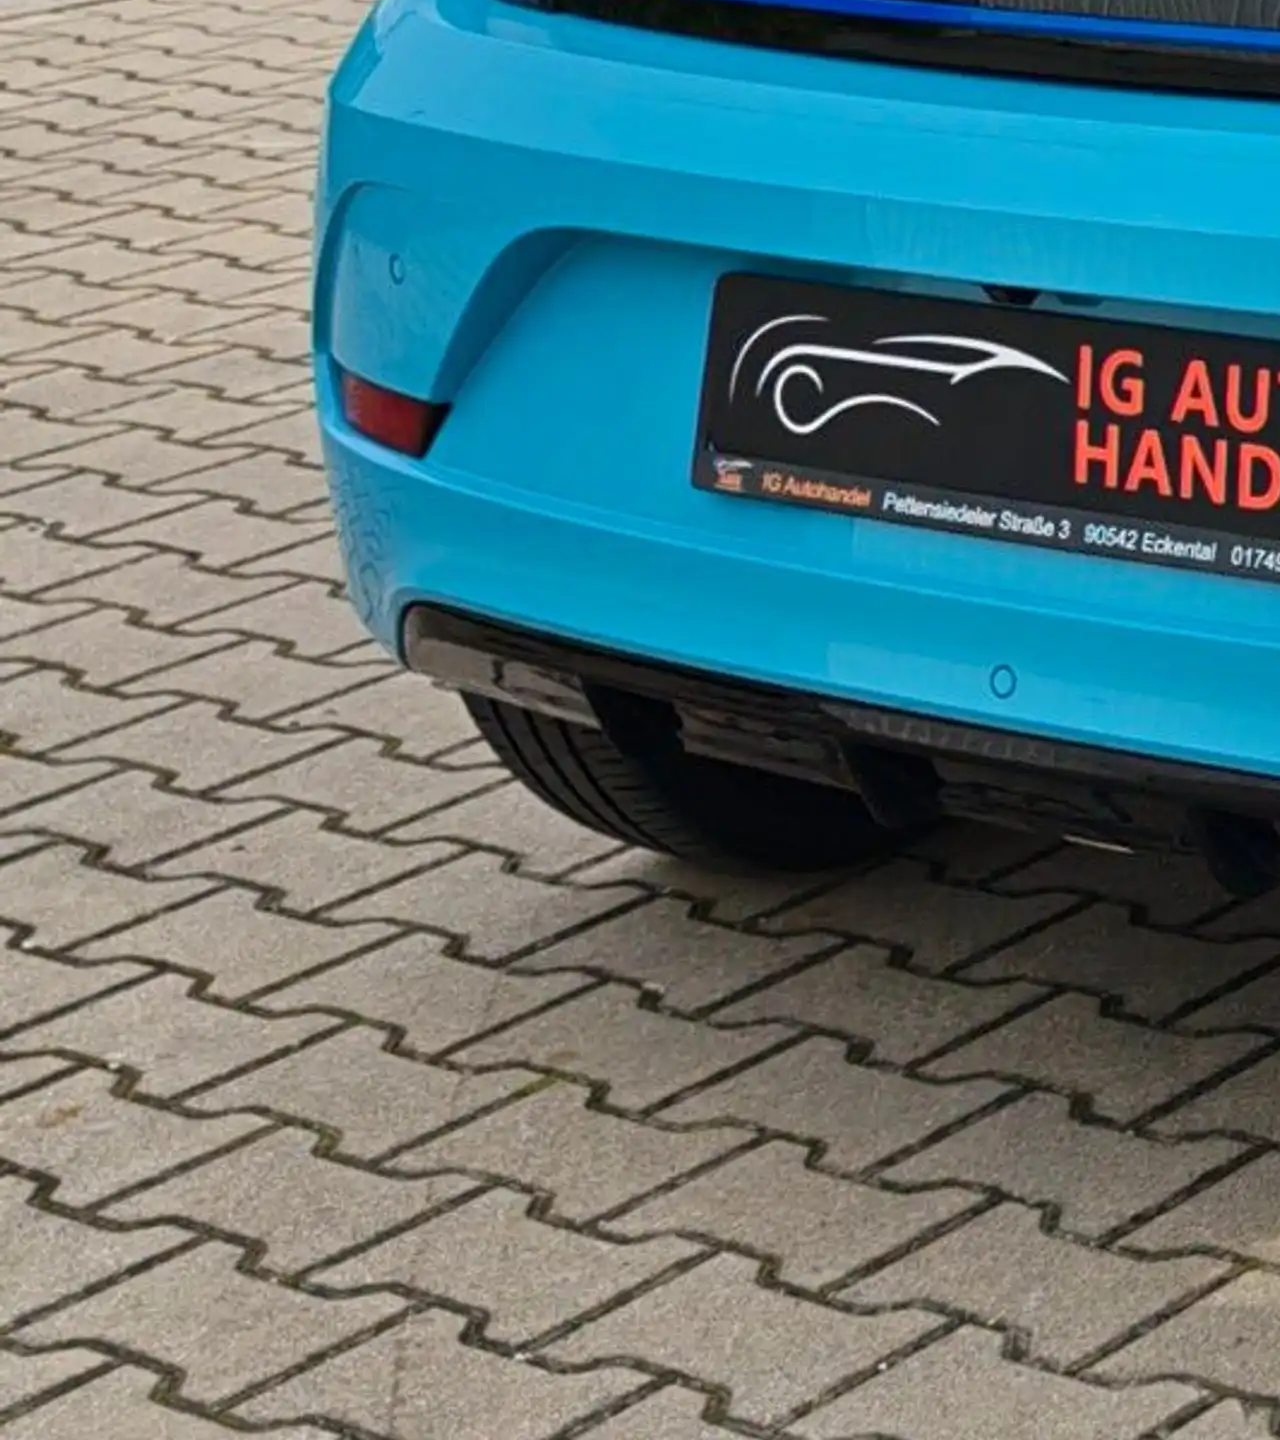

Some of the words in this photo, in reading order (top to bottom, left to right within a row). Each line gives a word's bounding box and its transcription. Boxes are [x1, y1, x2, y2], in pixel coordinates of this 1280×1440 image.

[1078, 344, 1145, 417] IG
[763, 471, 783, 493] IG
[785, 477, 871, 508] Autohandel
[998, 509, 1055, 537] Straße
[1058, 520, 1072, 539] 3
[1084, 522, 1137, 551] 90542
[1141, 532, 1217, 561] Eckental
